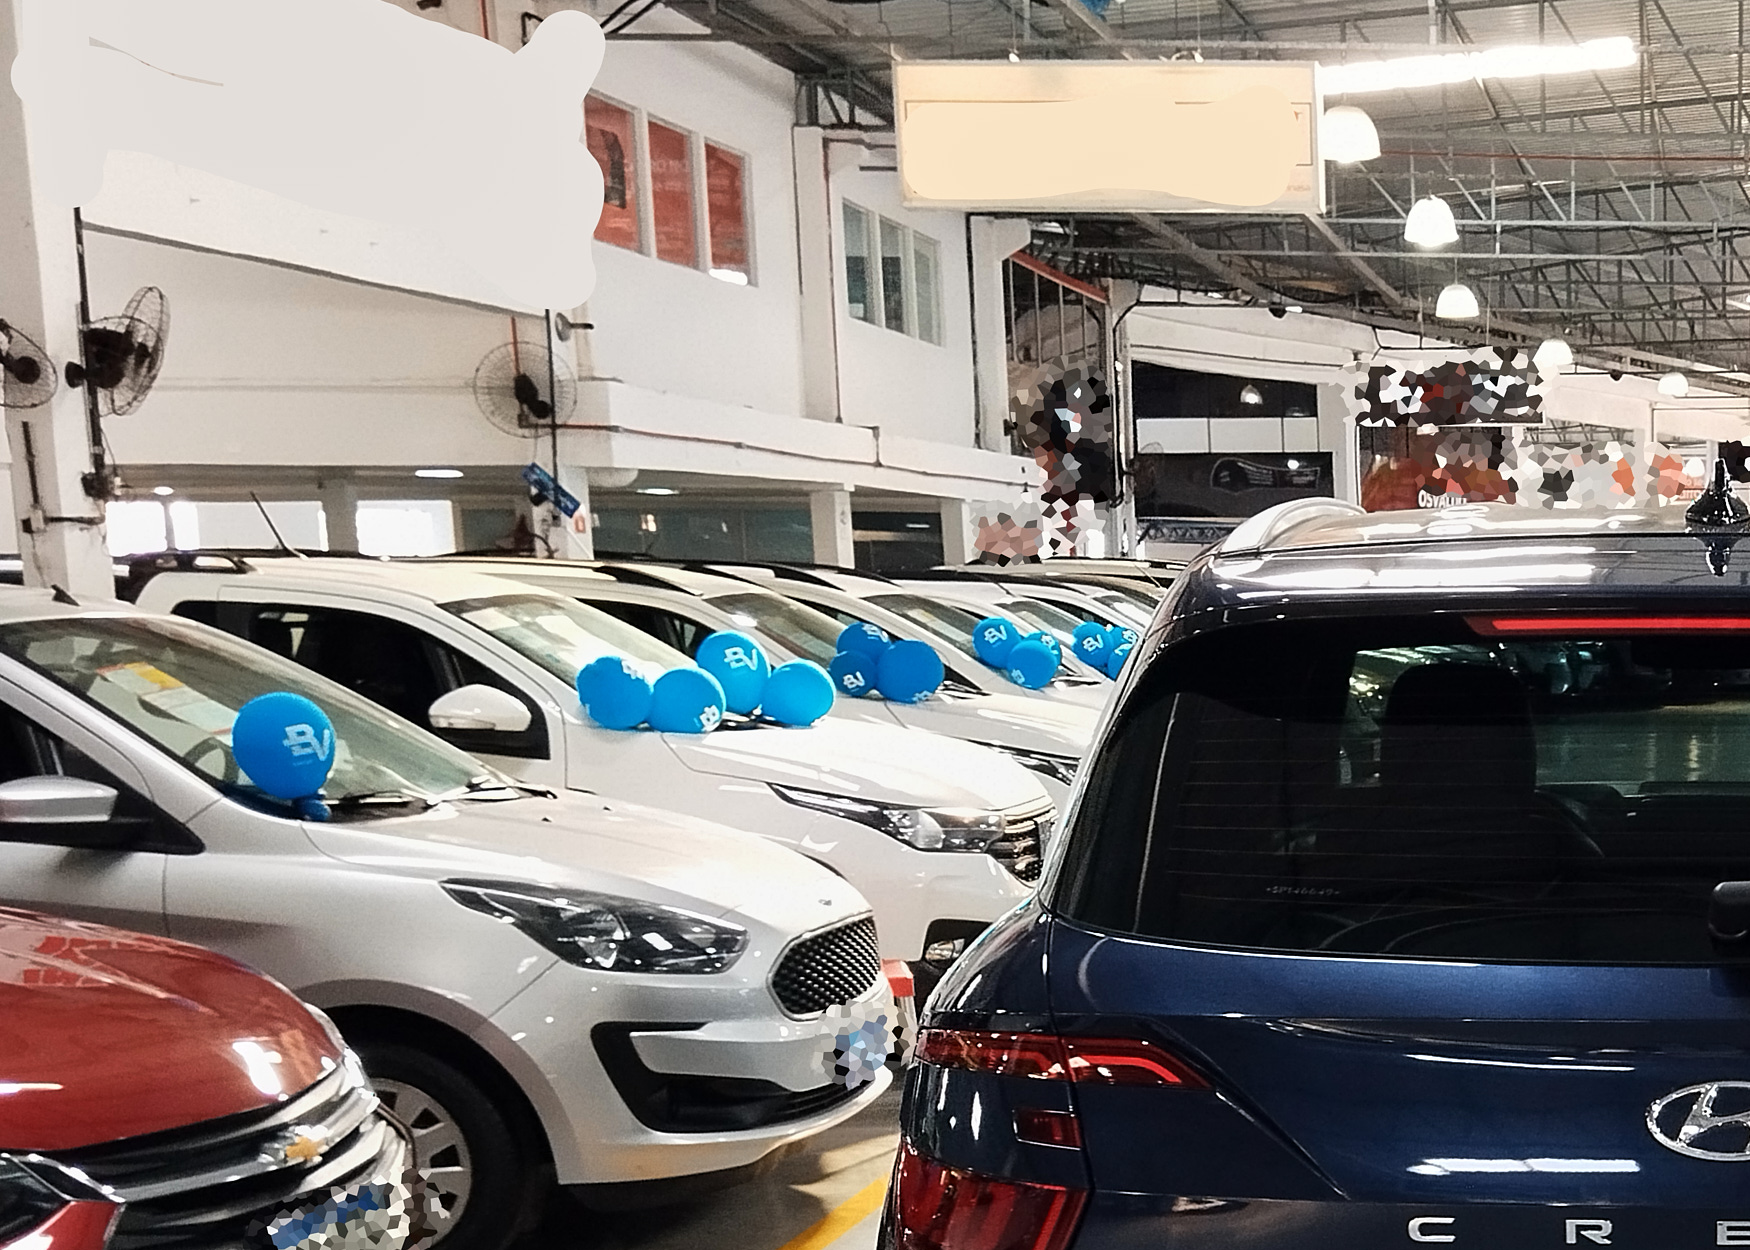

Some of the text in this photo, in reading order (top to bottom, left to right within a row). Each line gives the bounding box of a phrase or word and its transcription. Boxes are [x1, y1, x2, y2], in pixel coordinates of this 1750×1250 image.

[984, 625, 1008, 644] BV
[723, 646, 759, 671] BV
[282, 723, 331, 762] BV
